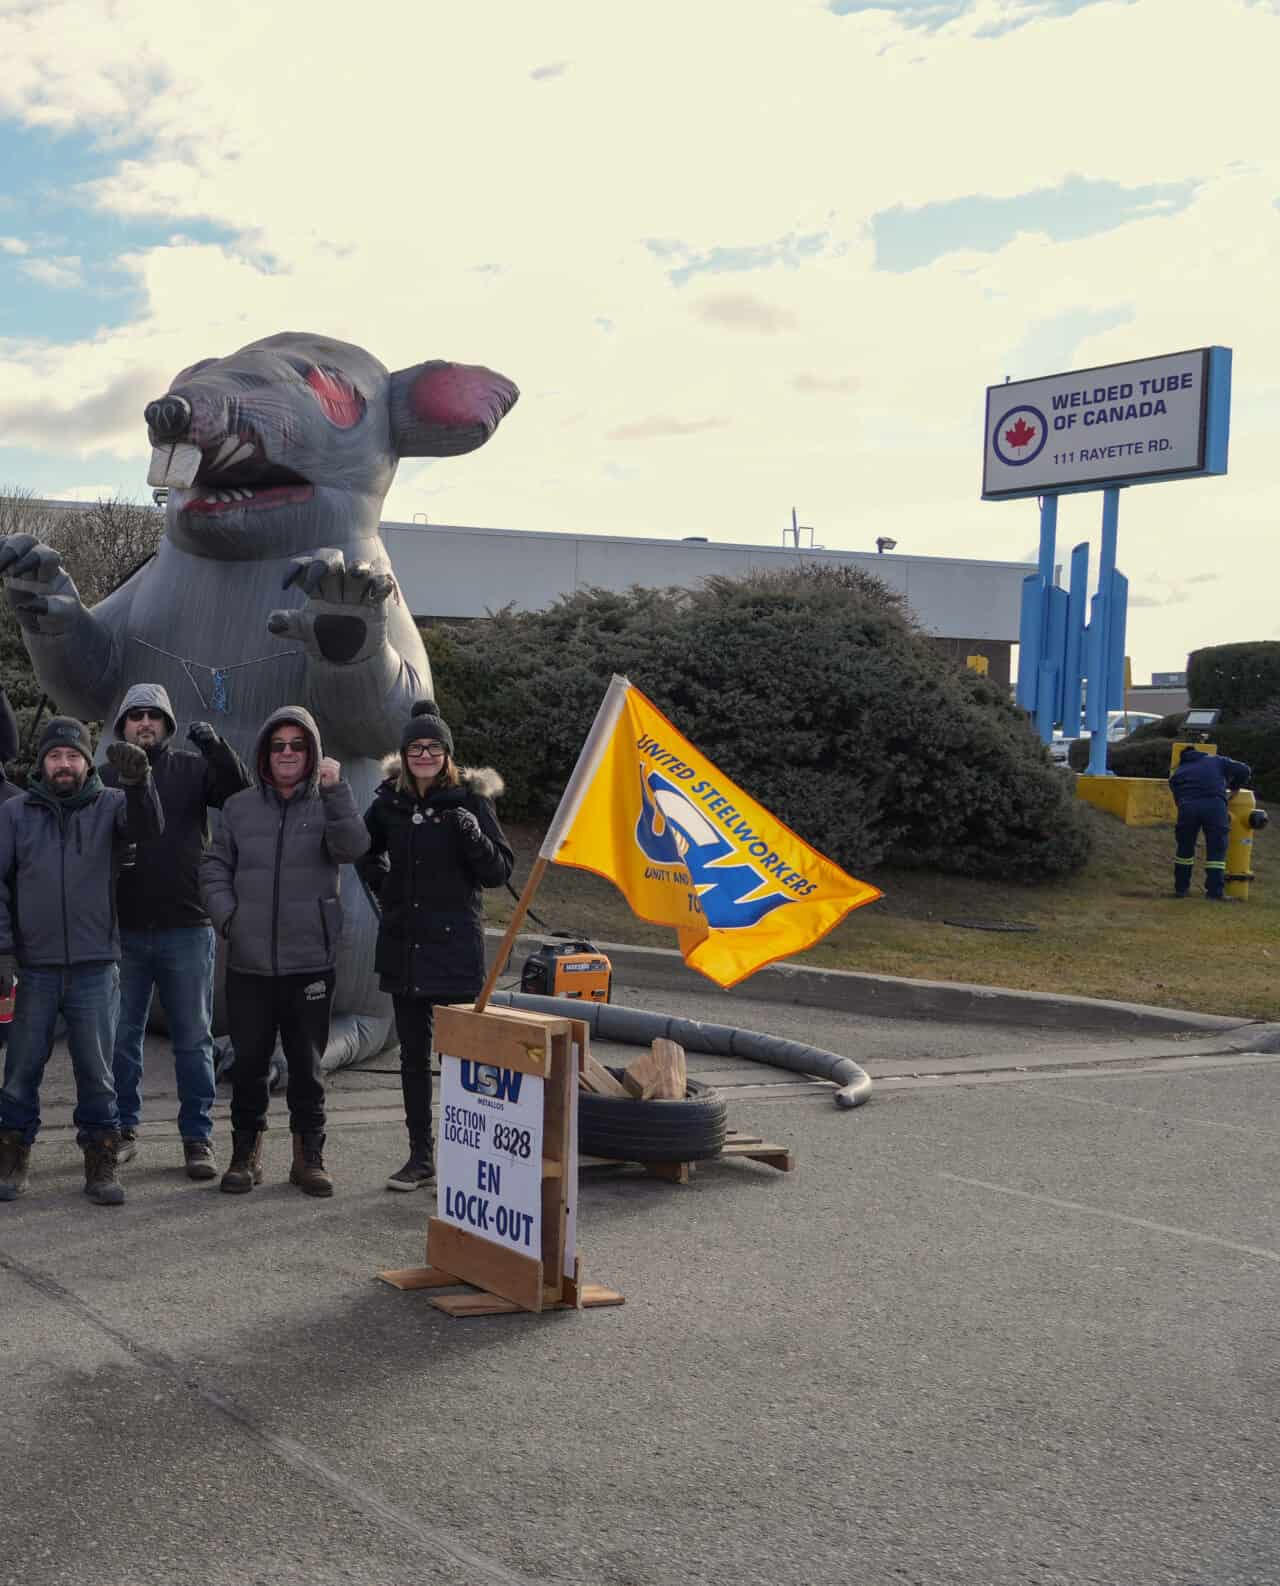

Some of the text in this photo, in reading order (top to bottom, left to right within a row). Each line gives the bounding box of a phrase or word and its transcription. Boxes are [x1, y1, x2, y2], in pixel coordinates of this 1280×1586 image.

[1052, 372, 1193, 410] WELDED TUBE
[1054, 399, 1167, 431] OF CANADA
[1053, 438, 1173, 464] 111 RAYETTE RD.
[637, 734, 817, 896] UNITED STEELWORKERS
[445, 1105, 486, 1132] SECTION
[445, 1123, 481, 1149] LOCALE
[493, 1123, 531, 1159] 8328
[478, 1159, 500, 1195] EN
[446, 1186, 534, 1247] LOCK-OUT
